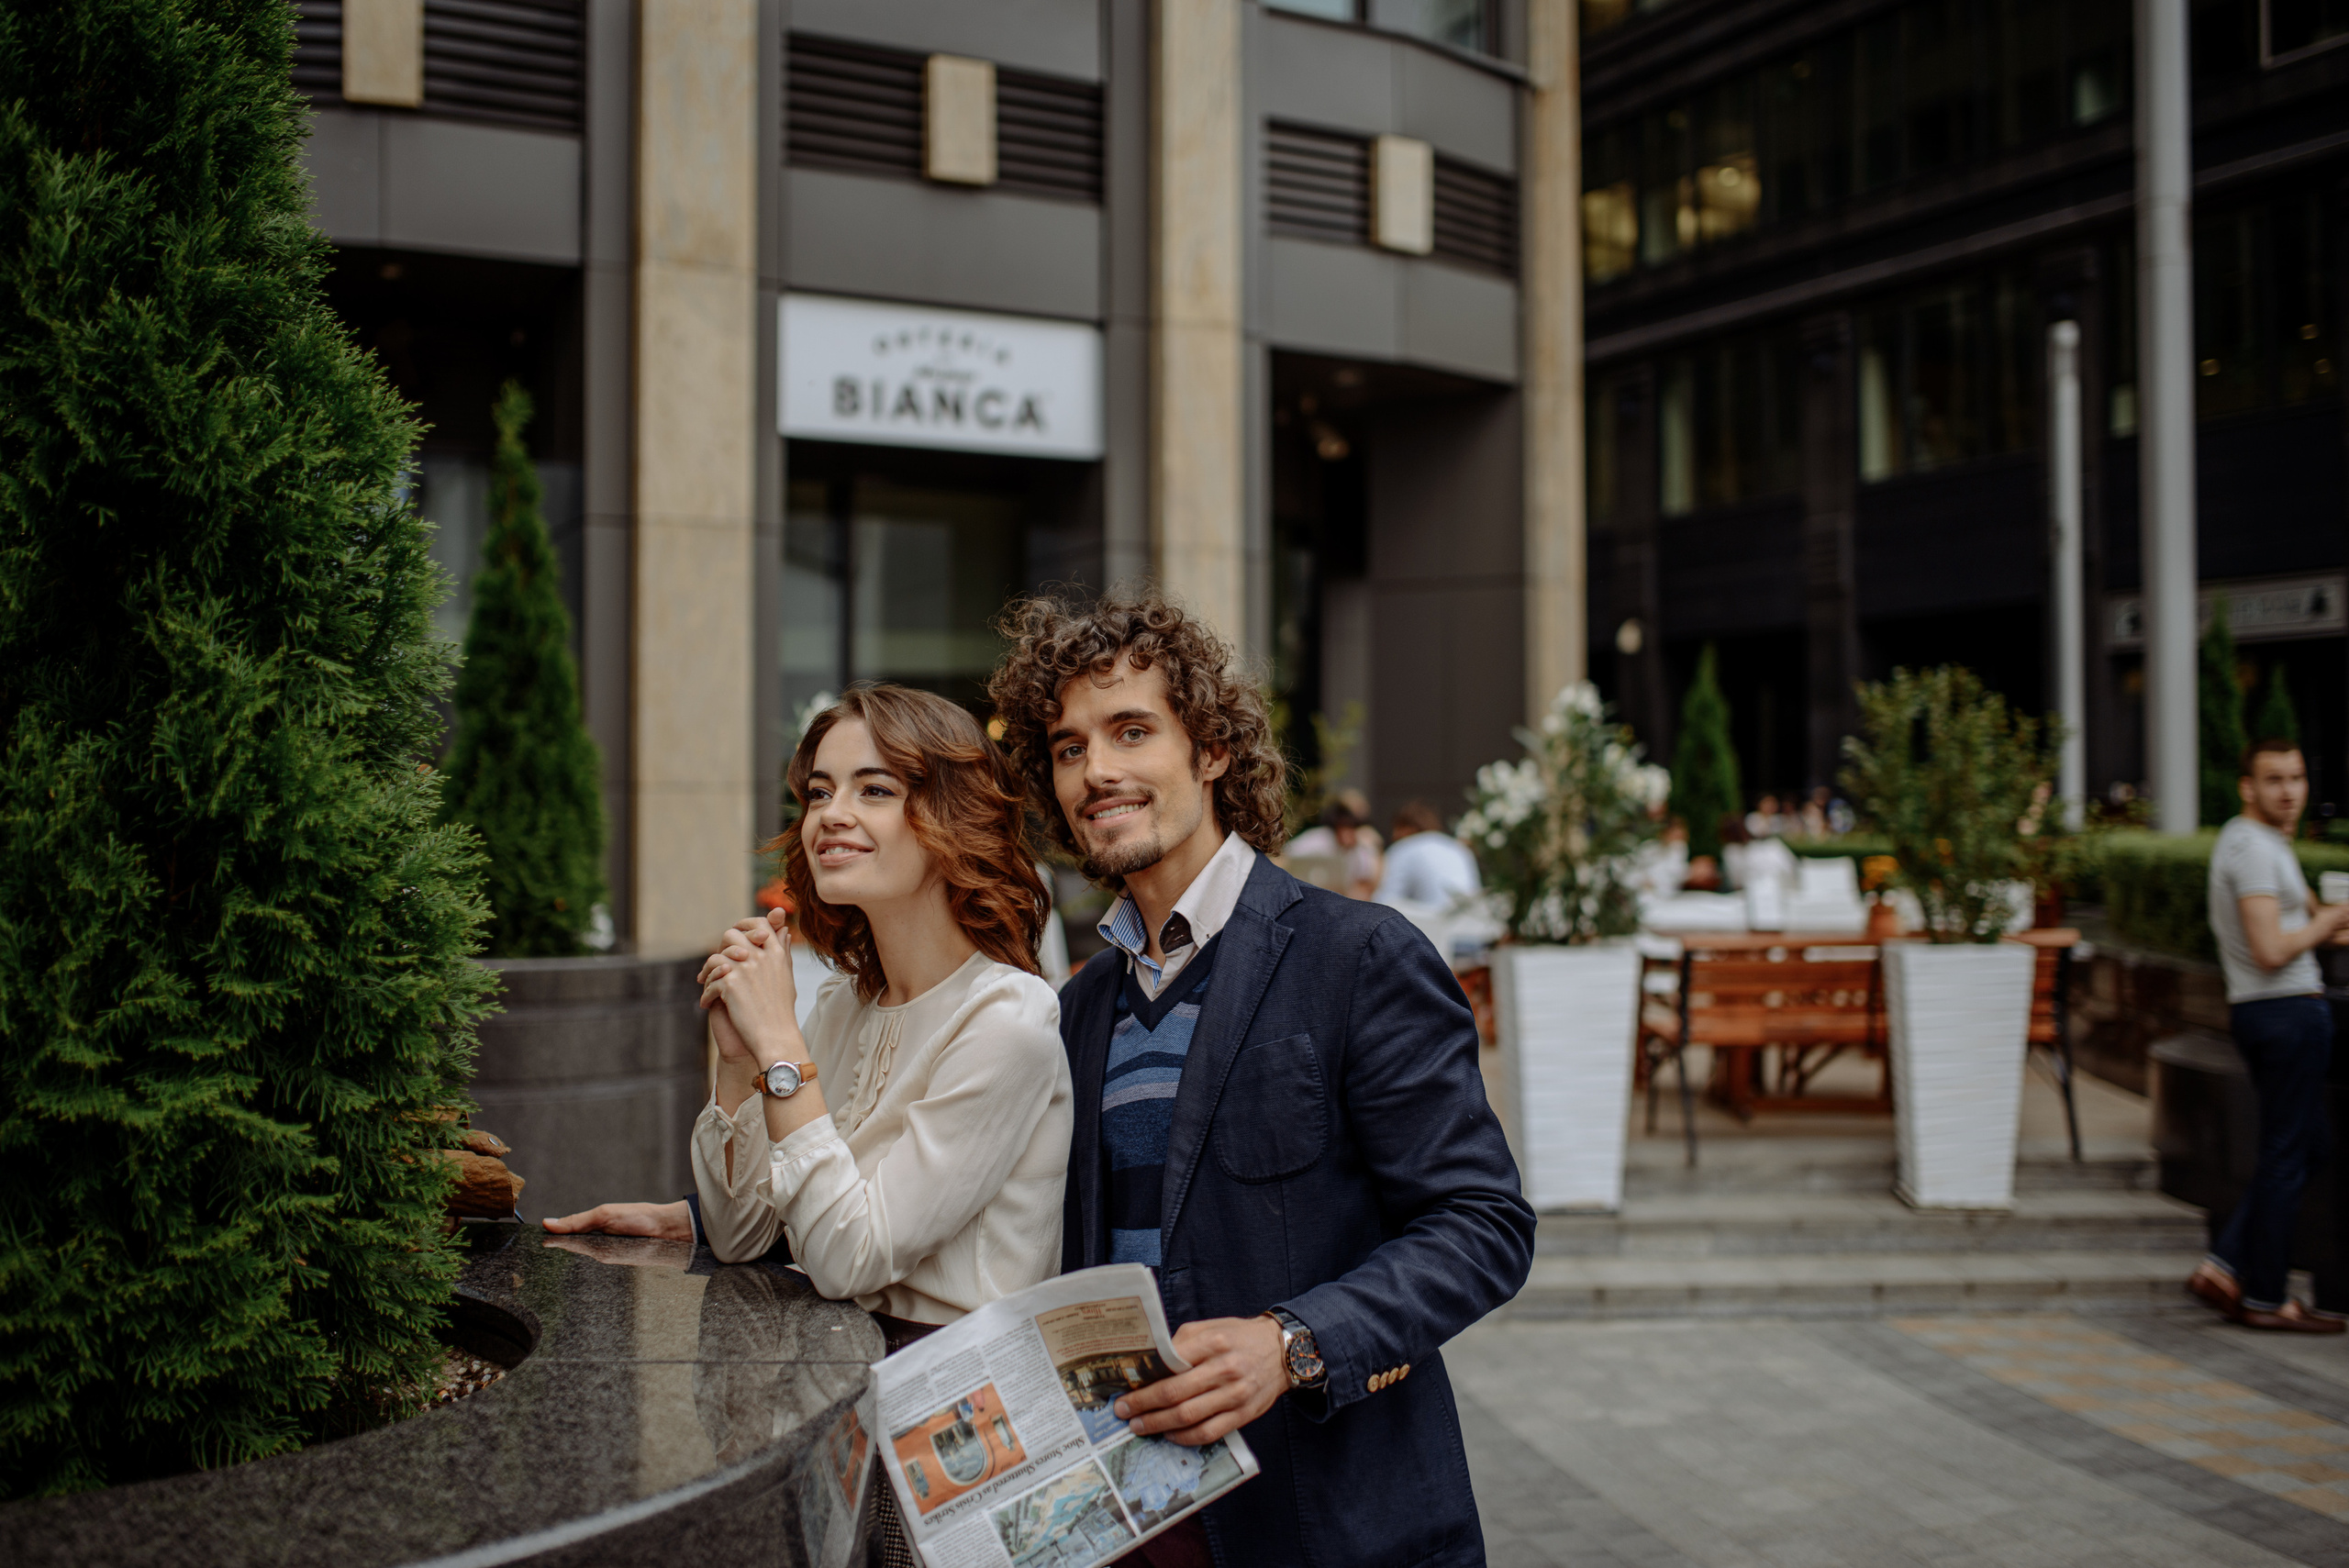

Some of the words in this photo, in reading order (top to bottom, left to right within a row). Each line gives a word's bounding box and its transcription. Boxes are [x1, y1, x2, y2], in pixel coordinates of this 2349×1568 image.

[832, 374, 1046, 431] BIANCA
[1062, 1436, 1085, 1451] Shoe
[1034, 1447, 1063, 1466] Stores
[992, 1462, 1036, 1494] Shuttered
[982, 1485, 992, 1495] as
[954, 1492, 983, 1510] Crisis
[923, 1505, 956, 1526] Strikes
